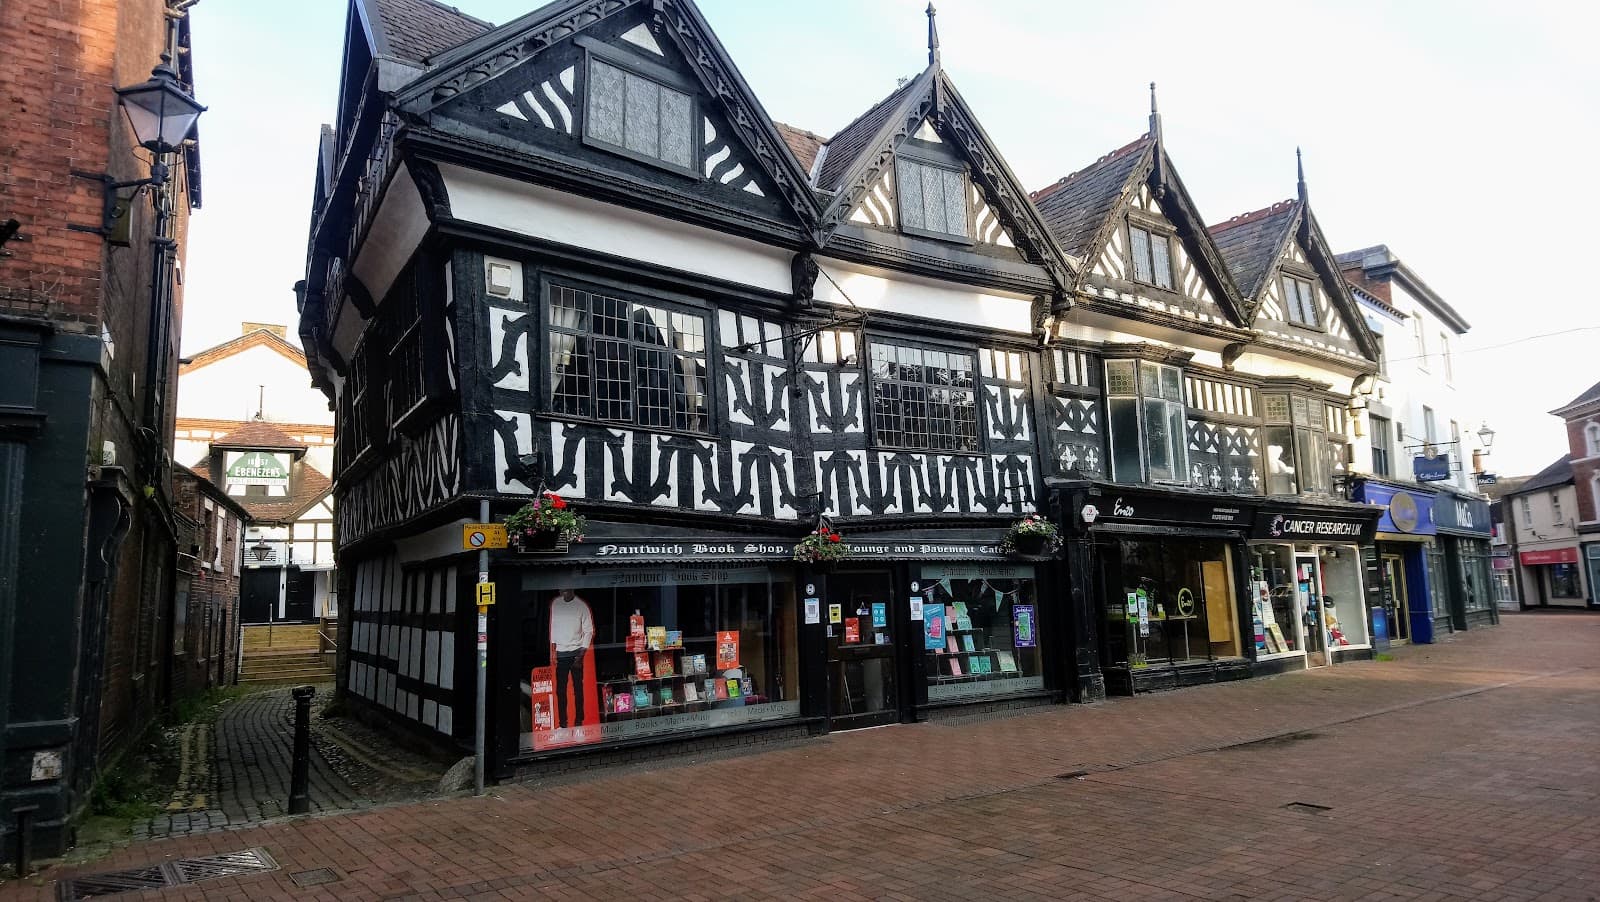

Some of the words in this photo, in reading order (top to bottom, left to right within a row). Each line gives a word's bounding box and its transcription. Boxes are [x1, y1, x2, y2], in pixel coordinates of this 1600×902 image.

[1283, 520, 1314, 534] CANCER
[1315, 521, 1351, 536] RESEARCH
[1351, 523, 1363, 536] UK
[596, 543, 683, 556] Nantwich
[692, 543, 736, 554] Book
[743, 543, 789, 555] Shop,
[846, 543, 890, 555] Lounge
[894, 544, 915, 553] and
[919, 544, 974, 555] Pavement
[480, 585, 493, 603] H
[601, 722, 624, 734] Music
